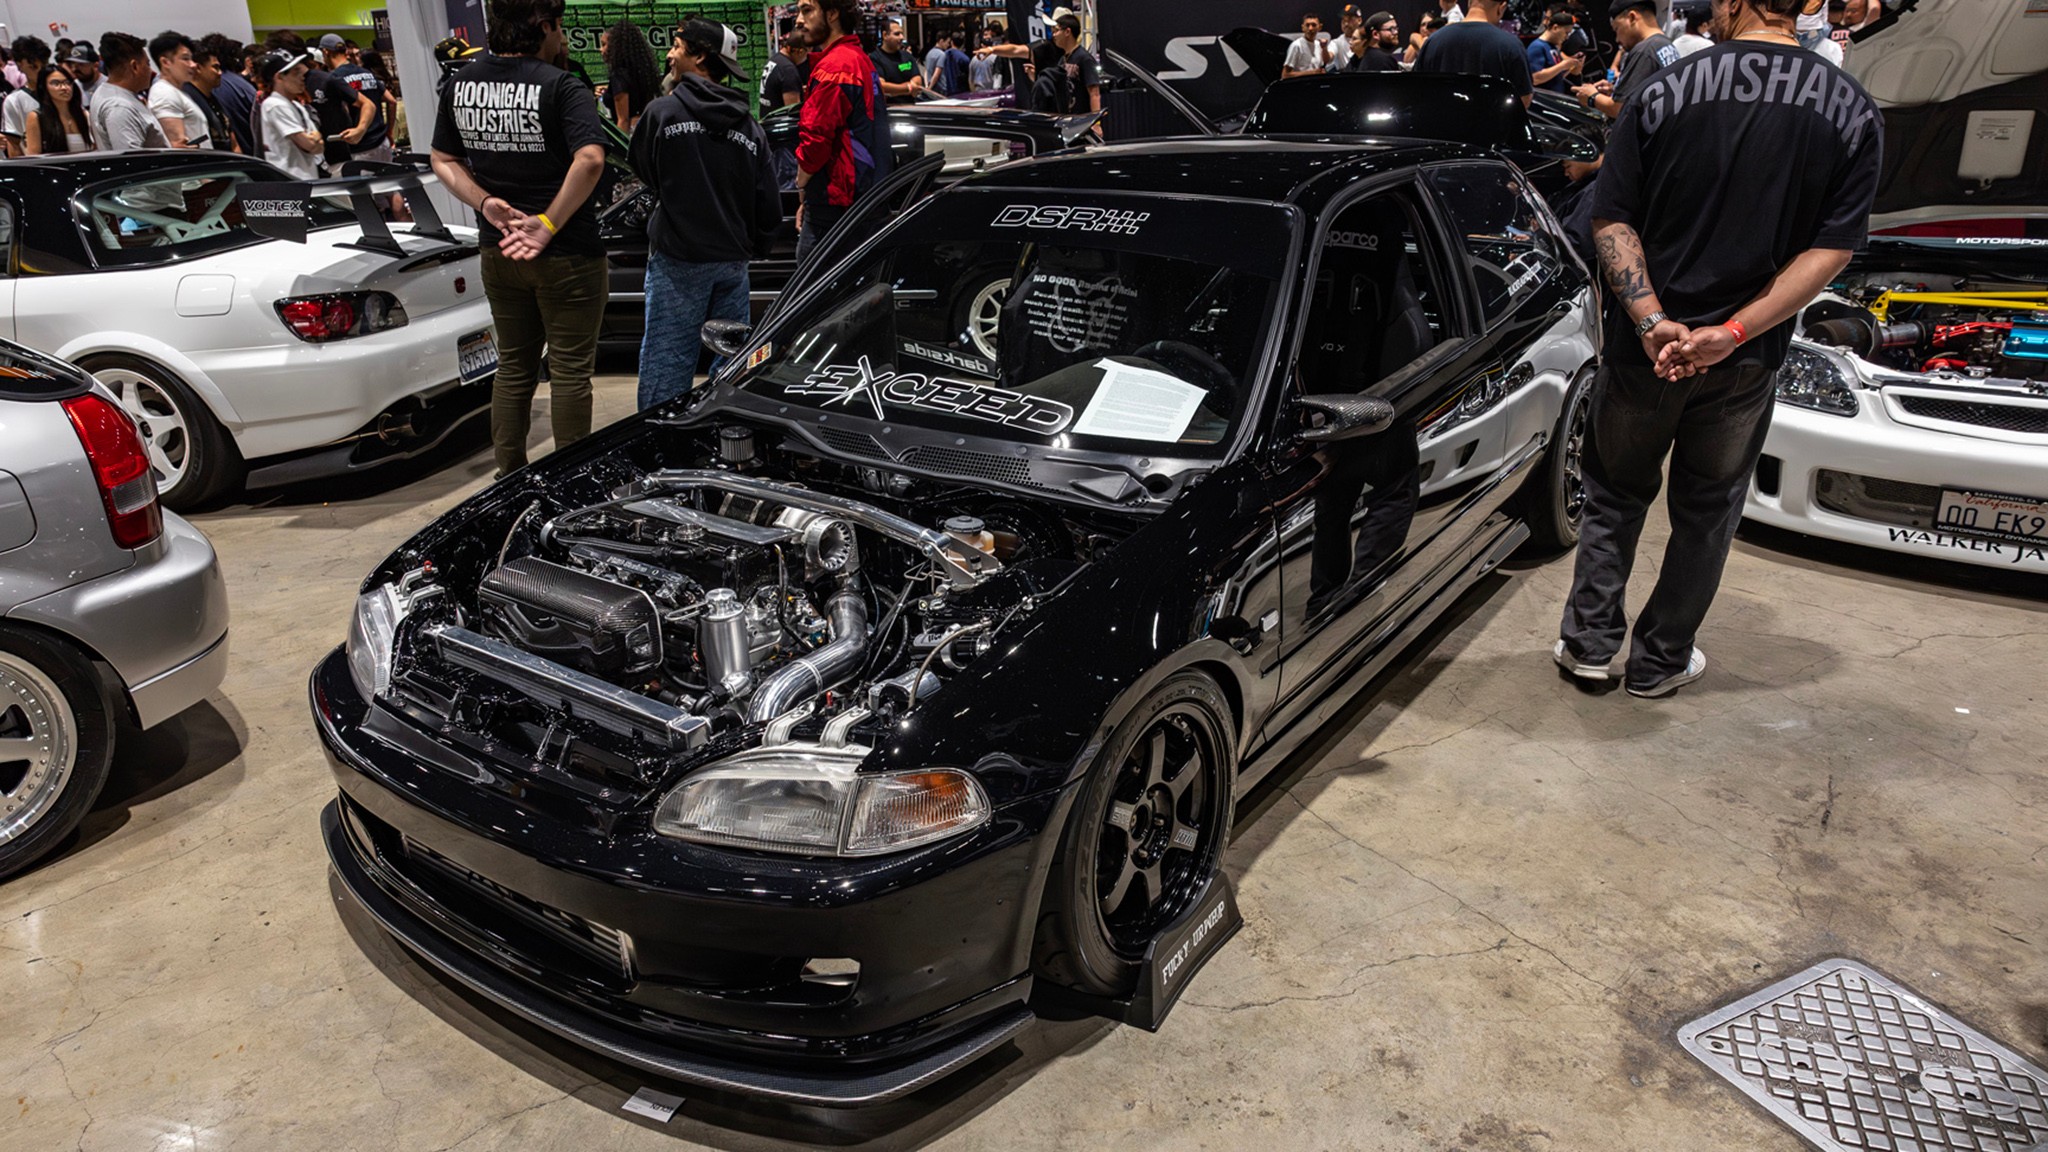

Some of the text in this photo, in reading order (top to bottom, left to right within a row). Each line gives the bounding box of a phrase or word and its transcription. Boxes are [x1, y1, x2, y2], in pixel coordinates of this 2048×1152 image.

[453, 81, 542, 110] HOONIGAN
[1641, 52, 1874, 158] GYMSHARK
[453, 107, 543, 134] INDUSTRIES
[243, 200, 303, 212] VOLTEX
[990, 204, 1107, 231] DSR
[1033, 274, 1046, 283] NO
[1048, 275, 1077, 287] GOOD
[784, 354, 1074, 435] EXCEED
[1994, 511, 2046, 536] EK9
[1888, 528, 2002, 554] WALKER
